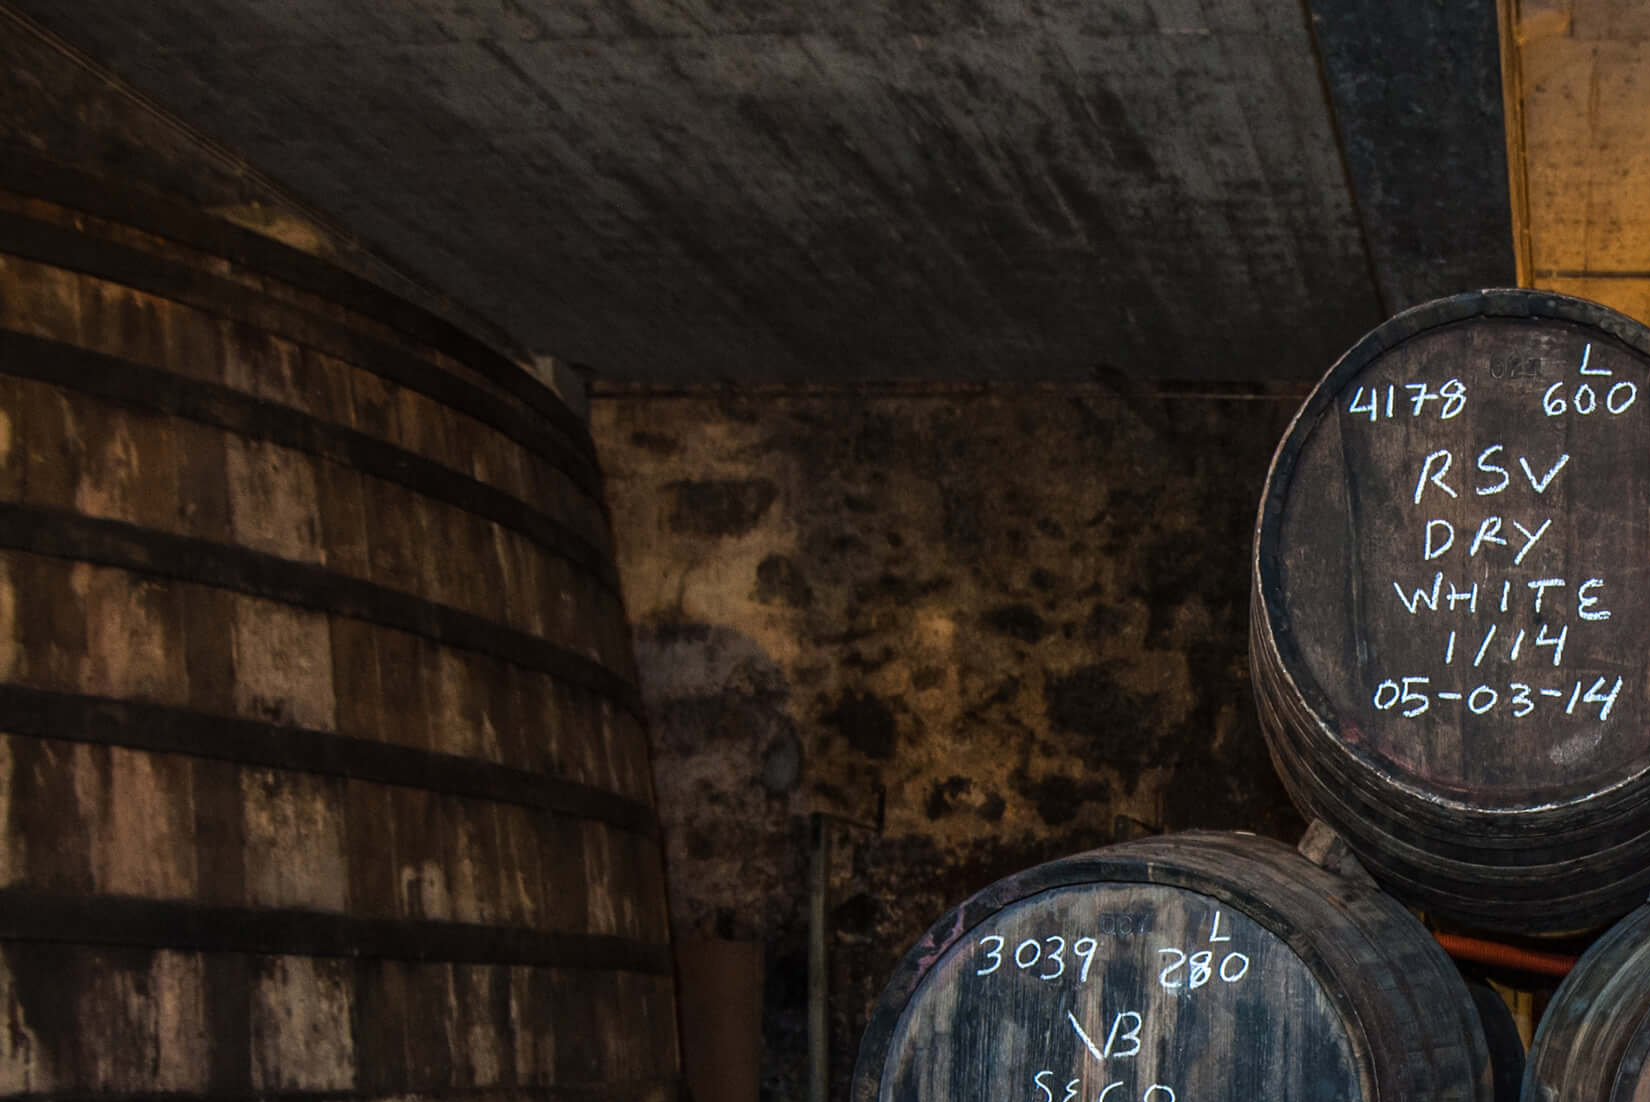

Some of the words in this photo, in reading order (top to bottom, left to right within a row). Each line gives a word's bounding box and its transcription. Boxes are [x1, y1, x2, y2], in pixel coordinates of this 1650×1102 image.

[1579, 342, 1613, 376] L
[1349, 378, 1468, 421] 4178
[1543, 381, 1637, 417] 600
[1414, 445, 1570, 504] RSV
[1424, 516, 1552, 565] DRY
[1393, 571, 1612, 620] WHITE
[1445, 624, 1568, 666] 1/14
[1373, 675, 1623, 721] 05-03-14
[1209, 911, 1230, 942] L
[977, 935, 1098, 983] 3039
